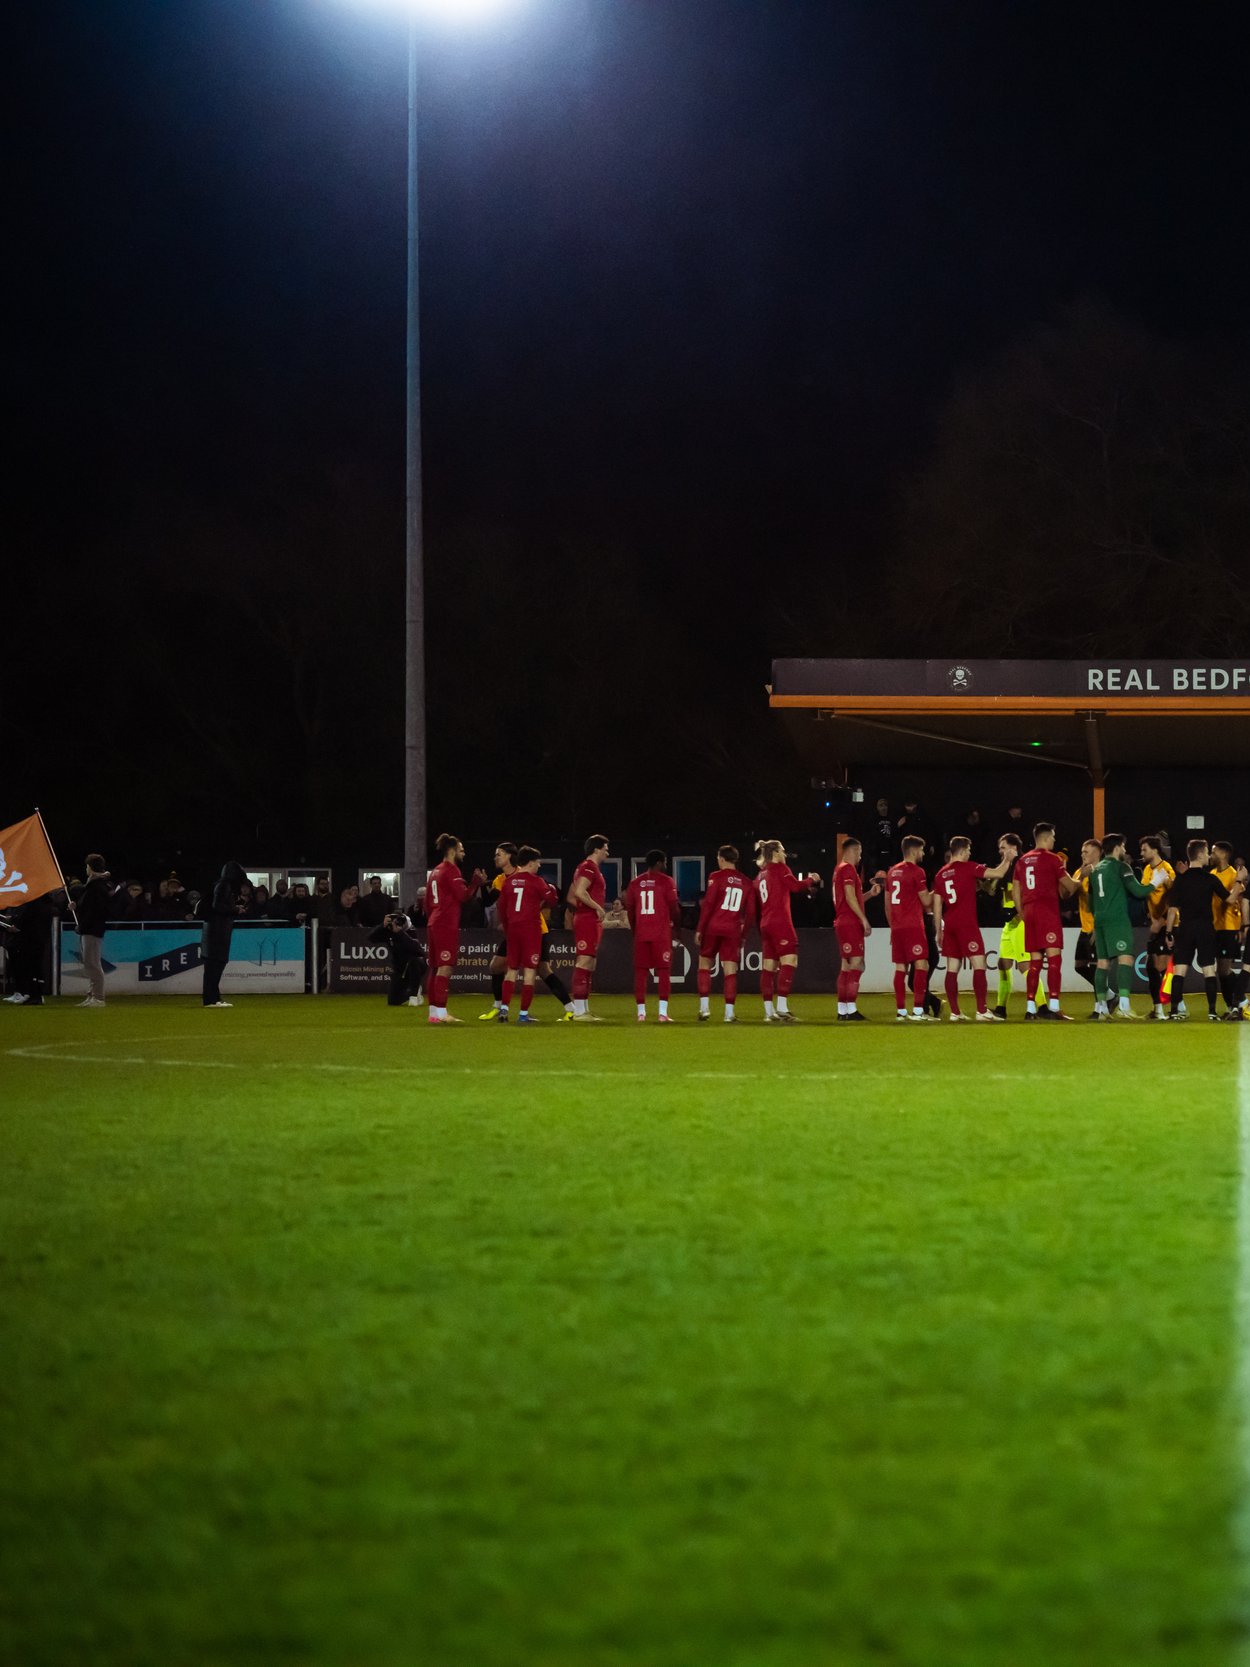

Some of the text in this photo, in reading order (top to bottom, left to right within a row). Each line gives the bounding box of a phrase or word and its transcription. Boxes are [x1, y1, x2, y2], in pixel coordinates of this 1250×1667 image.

[1088, 669, 1160, 690] REAL
[1025, 866, 1036, 890] 6
[1097, 873, 1105, 898] 1
[431, 880, 439, 904] 9
[513, 887, 524, 912] 7
[639, 890, 655, 915] 11
[720, 886, 743, 912] 10
[759, 879, 768, 904] 8
[891, 880, 901, 904] 2
[944, 879, 957, 904] 5
[340, 942, 389, 960] Luxo
[468, 944, 490, 955] paid
[549, 944, 568, 954] Ask
[456, 957, 489, 966] shrate
